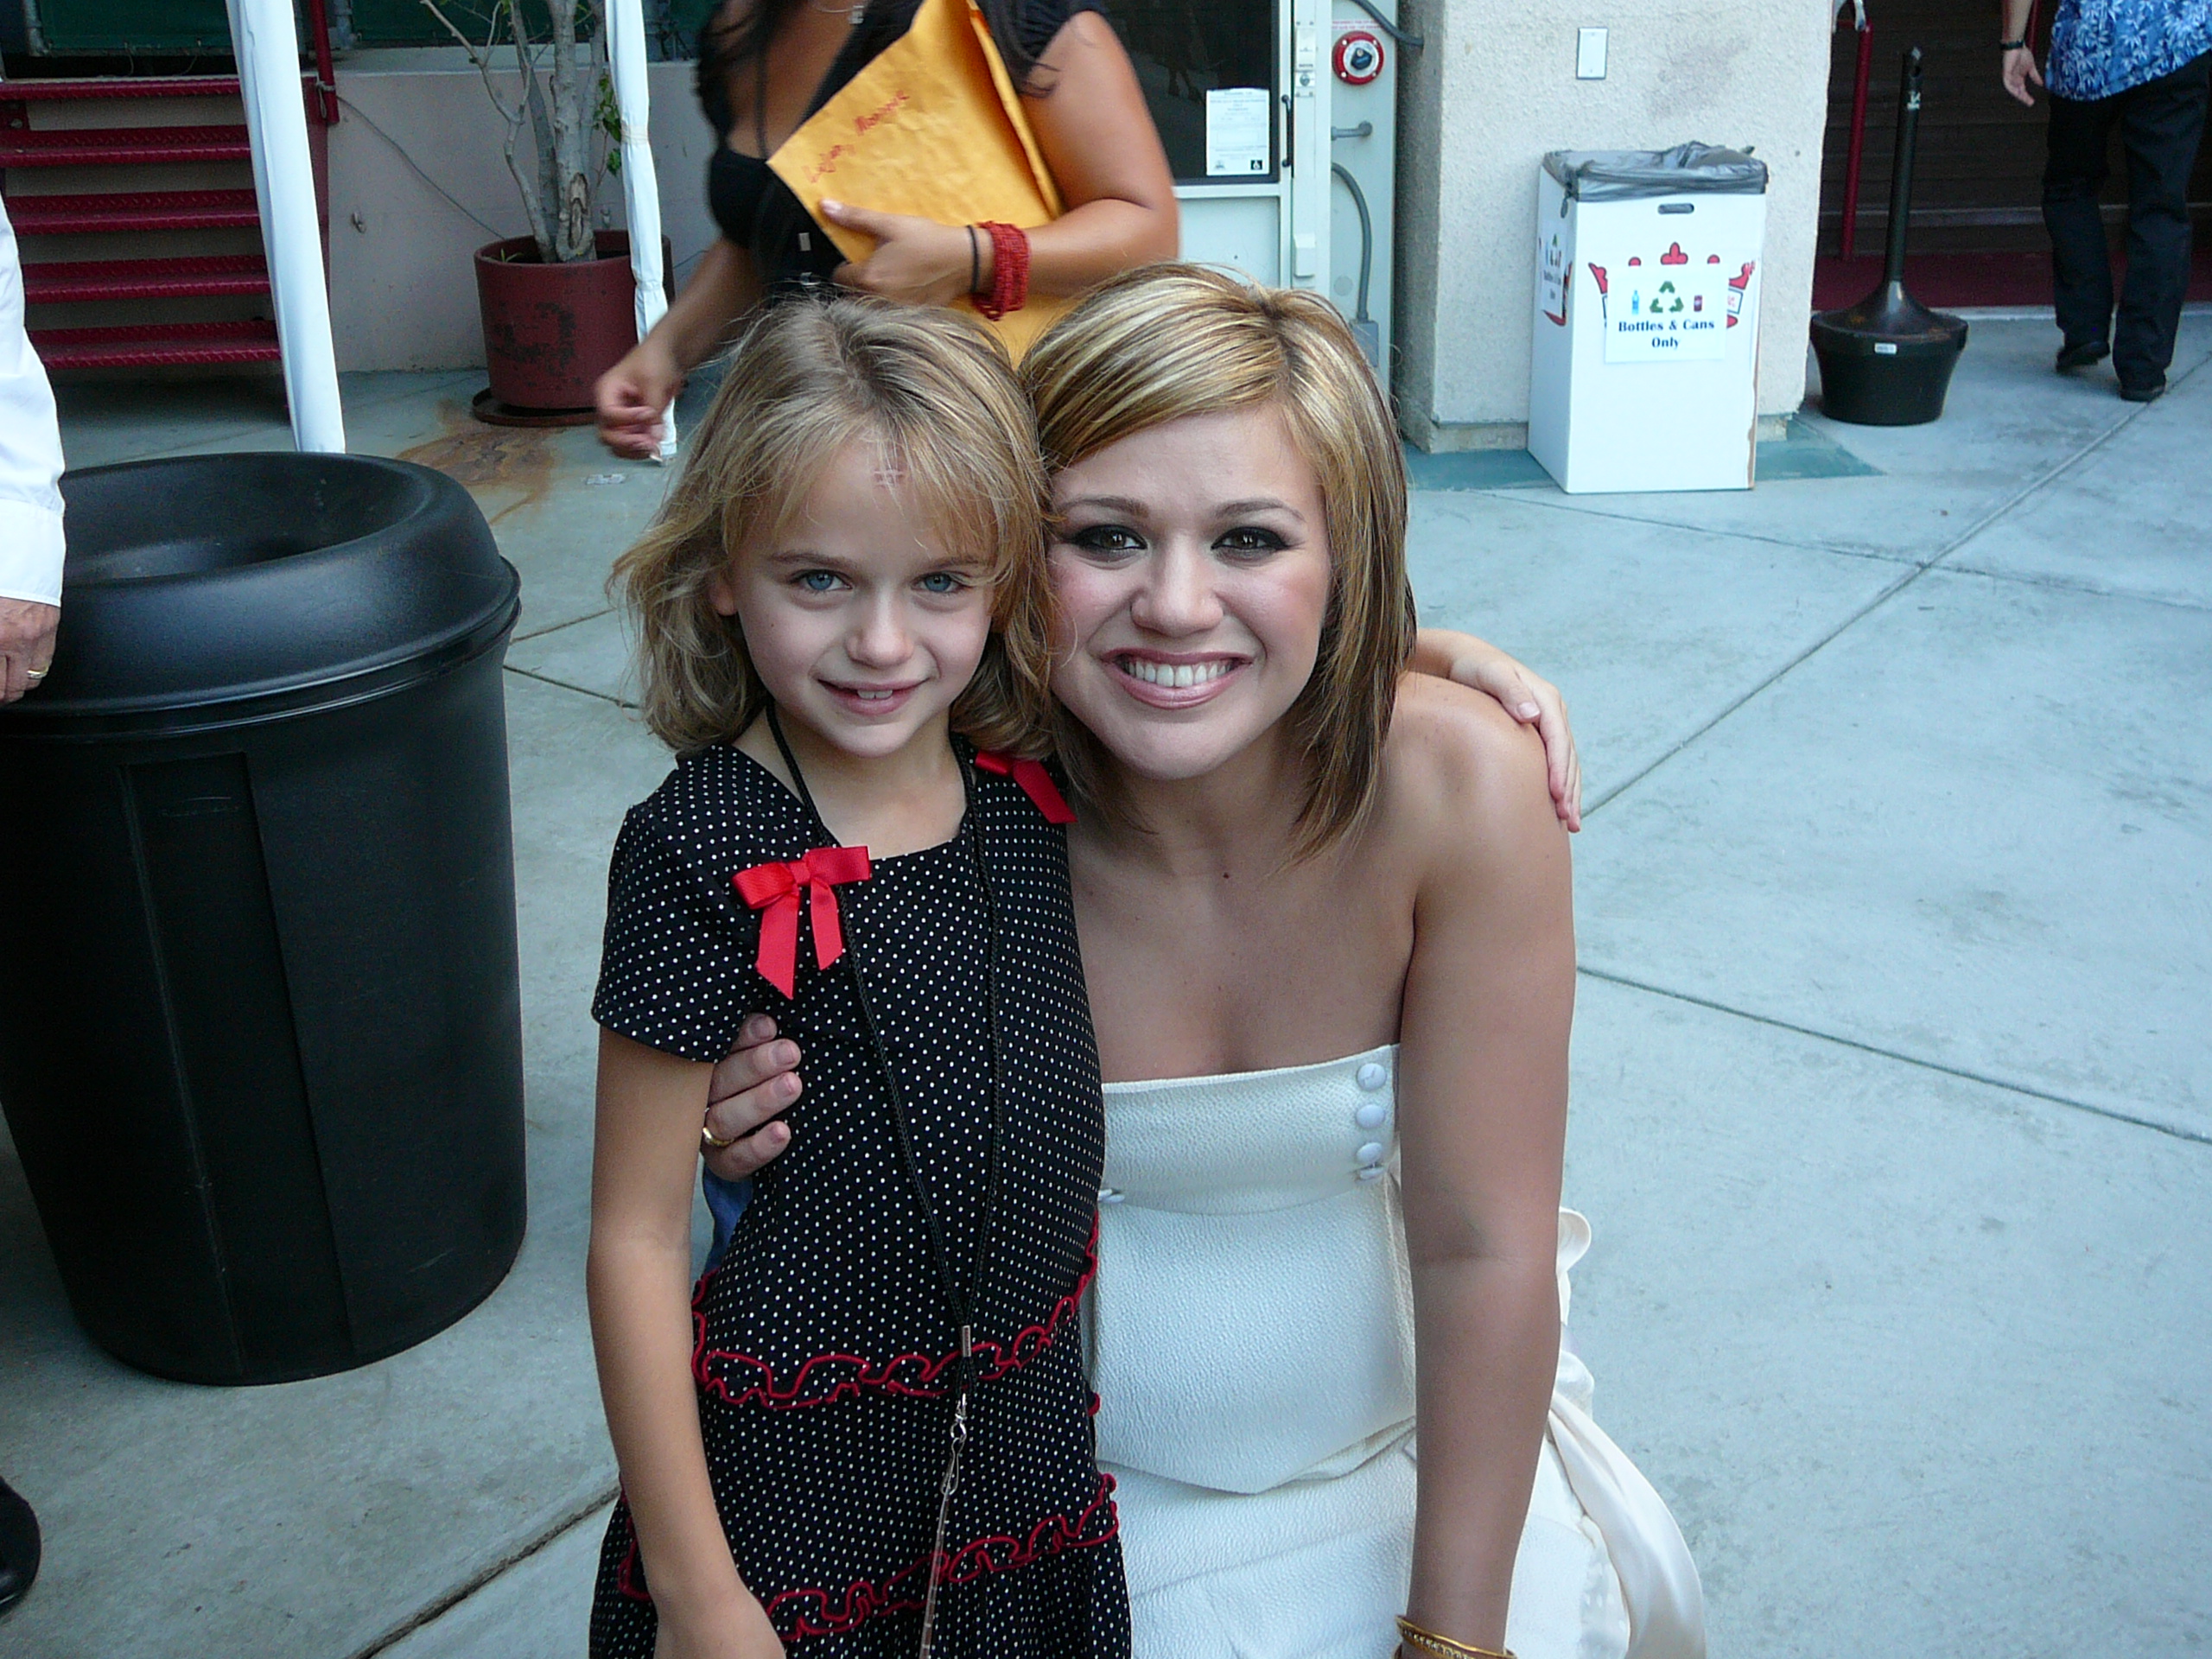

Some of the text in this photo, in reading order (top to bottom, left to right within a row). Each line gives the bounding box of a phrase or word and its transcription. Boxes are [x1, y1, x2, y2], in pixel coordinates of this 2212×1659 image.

[1618, 319, 1714, 332] Bottles & Cans
[1652, 337, 1679, 349] Only
